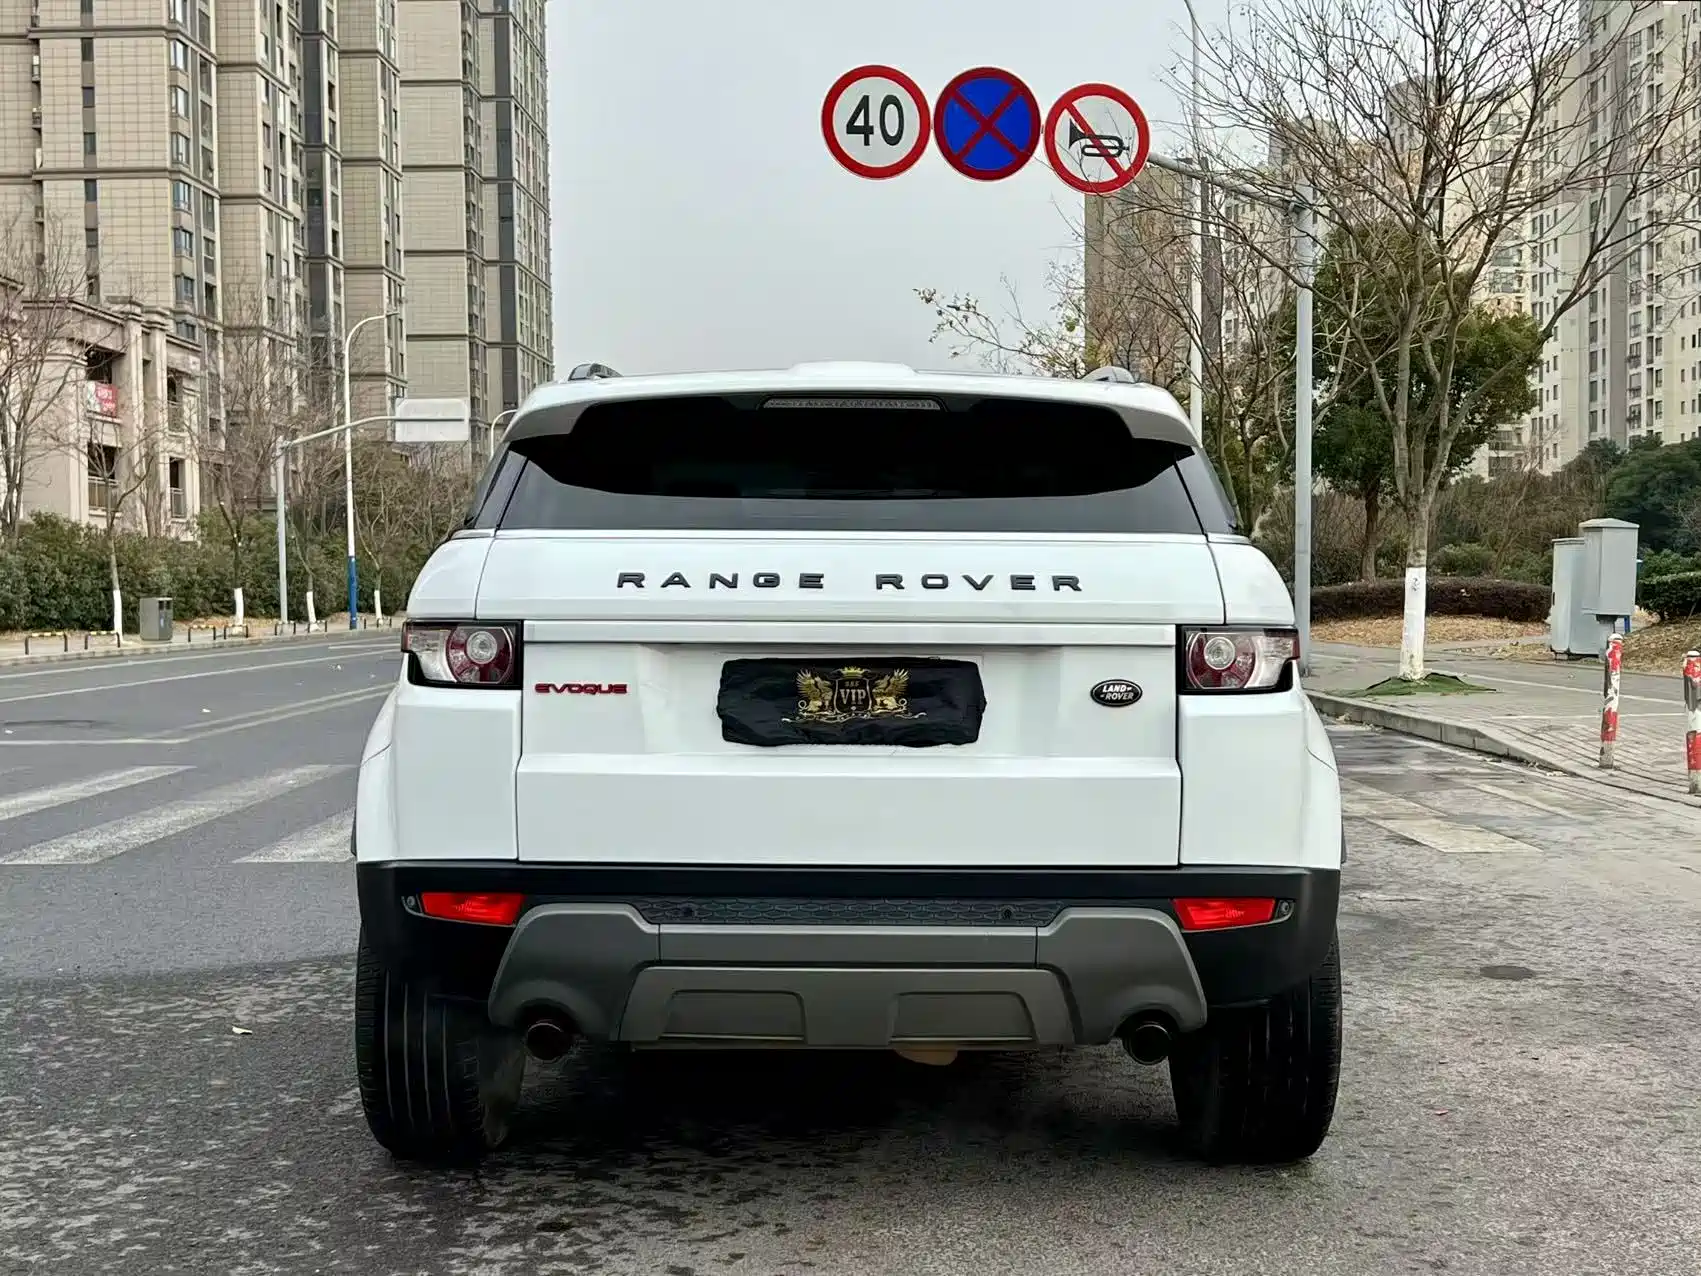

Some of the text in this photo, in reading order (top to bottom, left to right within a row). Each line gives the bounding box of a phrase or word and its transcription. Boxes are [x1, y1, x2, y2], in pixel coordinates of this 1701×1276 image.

[845, 94, 905, 147] 40
[616, 571, 1083, 592] RANGE ROVER
[534, 683, 628, 696] EVOQUE
[839, 688, 867, 705] VIP
